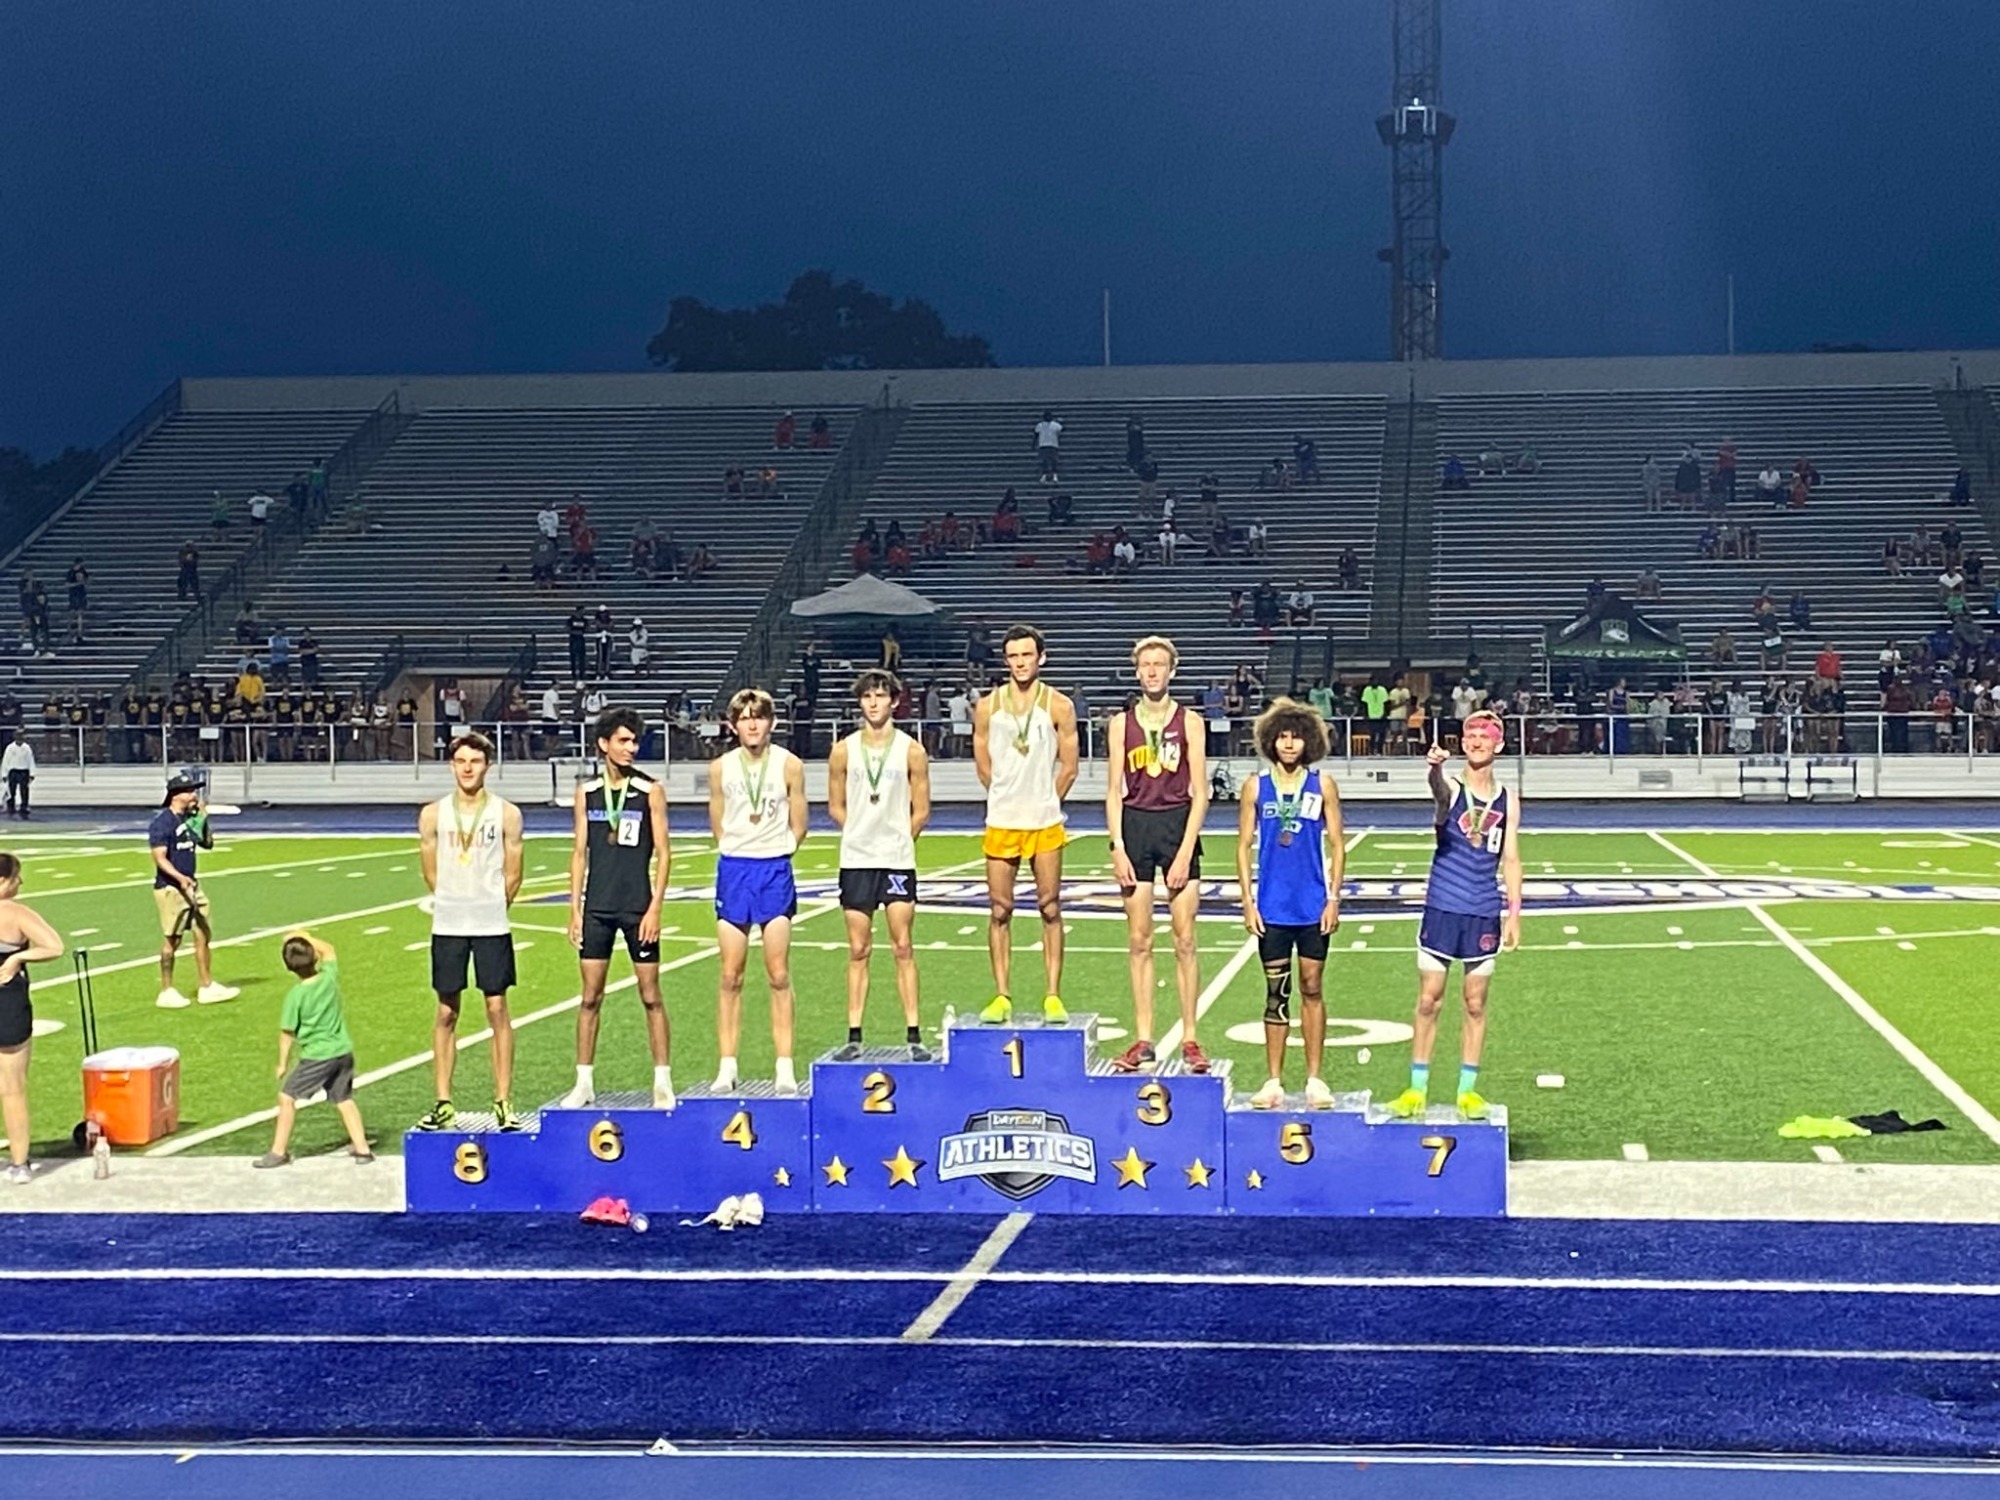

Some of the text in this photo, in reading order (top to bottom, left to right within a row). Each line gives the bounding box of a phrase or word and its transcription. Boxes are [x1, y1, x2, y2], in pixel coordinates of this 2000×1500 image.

[479, 824, 496, 842] 14
[624, 822, 633, 841] 2
[887, 874, 909, 895] X
[1003, 1039, 1022, 1077] 1
[863, 1072, 894, 1112] 2
[1137, 1083, 1170, 1125] 3
[588, 1120, 622, 1161] 6
[722, 1111, 756, 1149] 4
[1280, 1123, 1311, 1163] 5
[454, 1143, 487, 1183] 8
[944, 1136, 1092, 1169] ATHLETICS
[1422, 1136, 1454, 1175] 7
